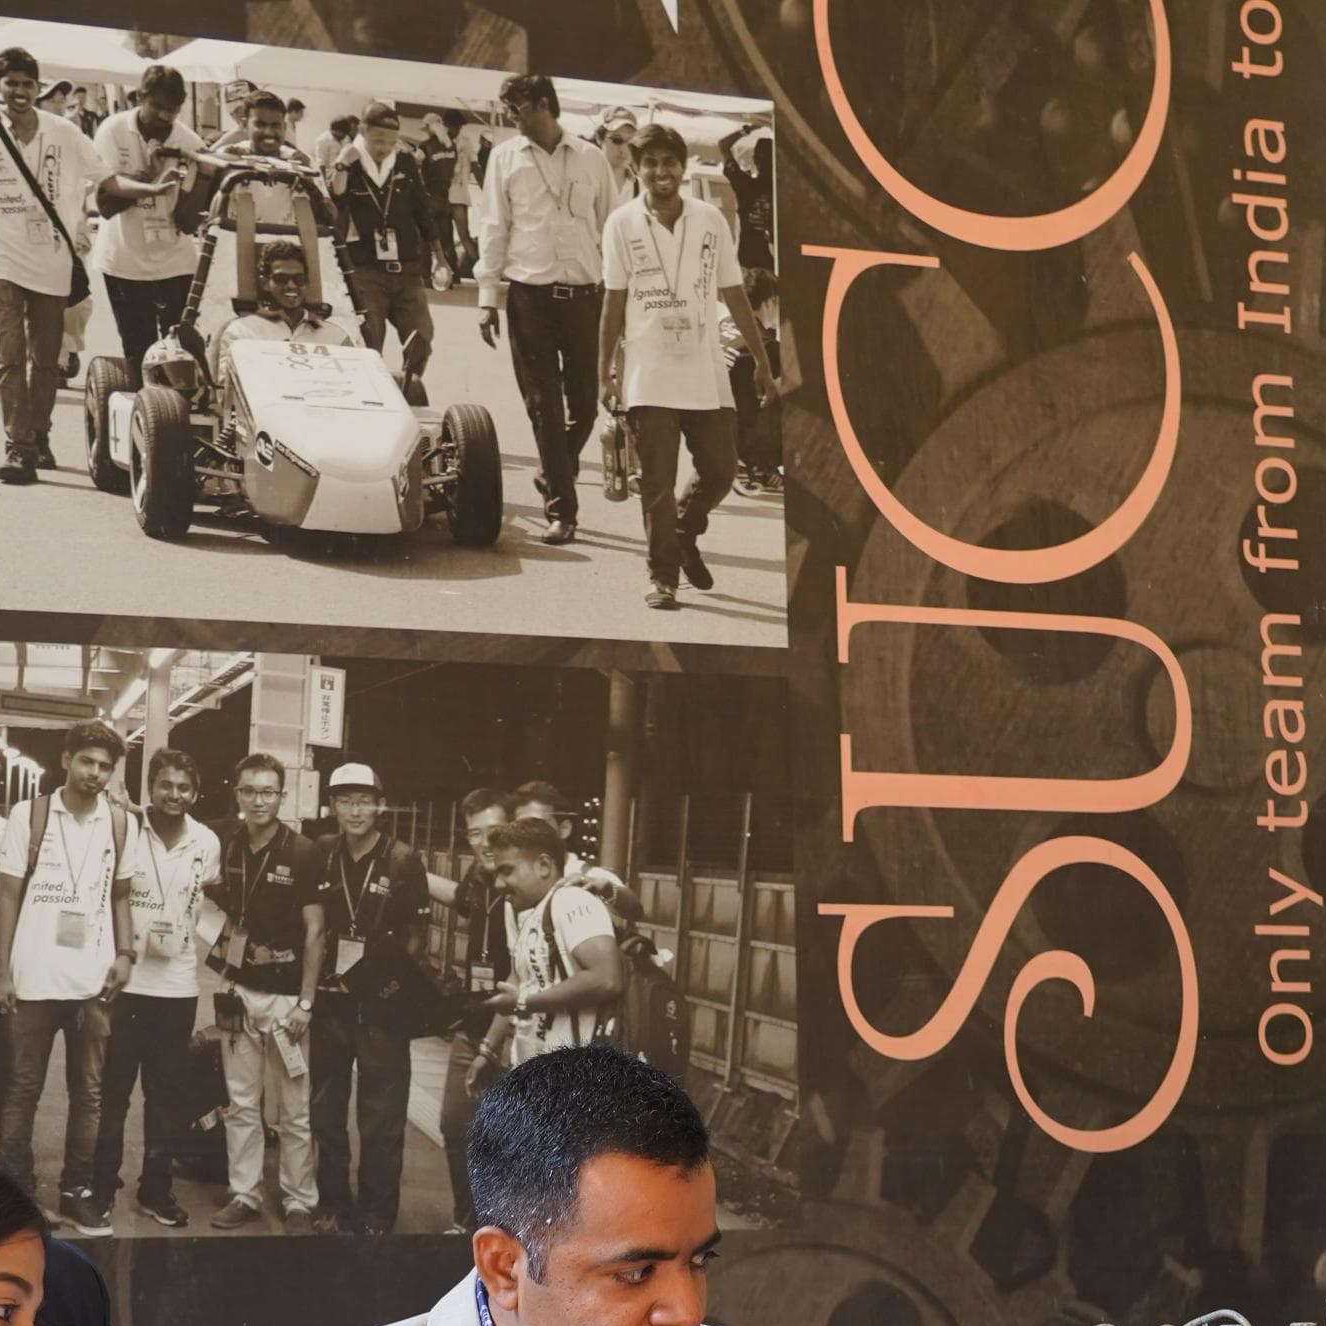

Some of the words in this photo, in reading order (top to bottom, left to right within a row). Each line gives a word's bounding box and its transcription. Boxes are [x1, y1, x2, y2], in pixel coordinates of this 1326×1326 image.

[1231, 0, 1284, 79] to
[1231, 118, 1292, 334] India
[1242, 373, 1298, 573] from
[1256, 613, 1309, 832] team
[1255, 868, 1323, 1065] Only
